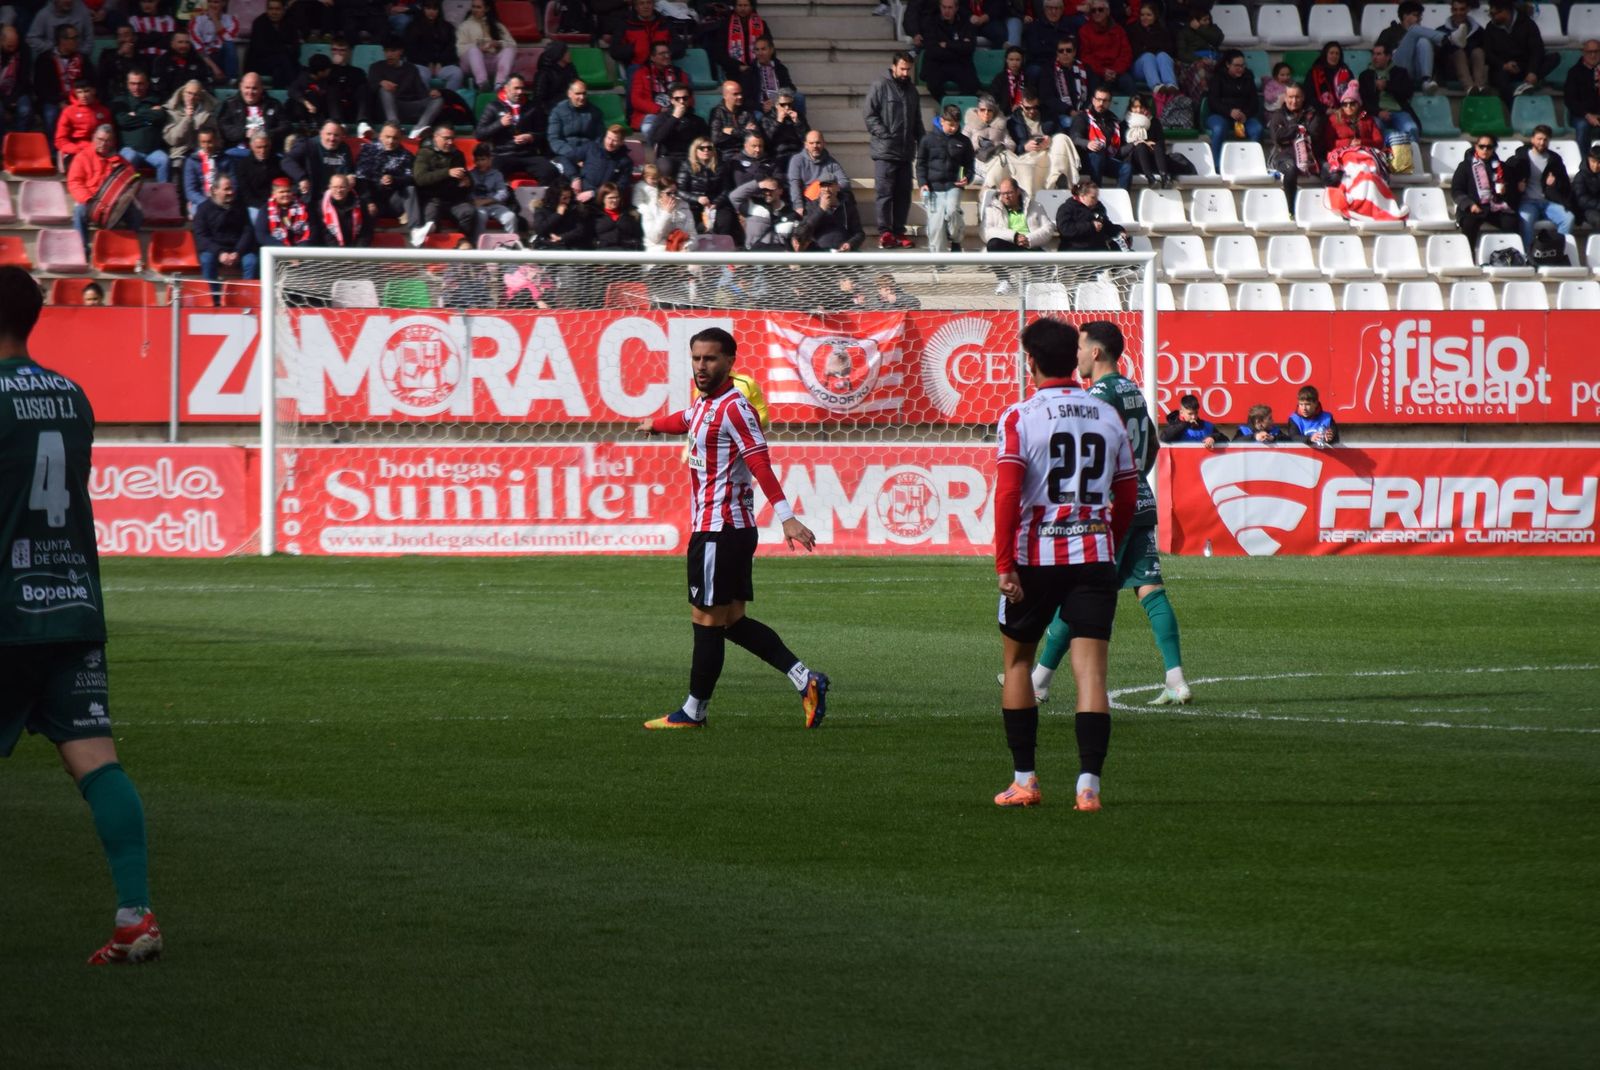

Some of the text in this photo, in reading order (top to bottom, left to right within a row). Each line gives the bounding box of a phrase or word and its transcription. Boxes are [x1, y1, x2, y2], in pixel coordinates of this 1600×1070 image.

[1393, 319, 1530, 384] fisio
[1394, 366, 1552, 415] readapt
[12, 396, 57, 420] ELISEO
[1046, 403, 1100, 421] J. SANCHO
[28, 430, 70, 528] 4
[378, 457, 502, 485] bodegas
[1047, 431, 1106, 505] 22
[324, 466, 666, 522] Sumiller
[1318, 476, 1599, 529] FRIMAY
[35, 539, 72, 552] XUNTA
[327, 532, 666, 549] www.bodegasdelsumiller.com
[34, 553, 51, 565] DE
[22, 584, 88, 607] Bopeixe
